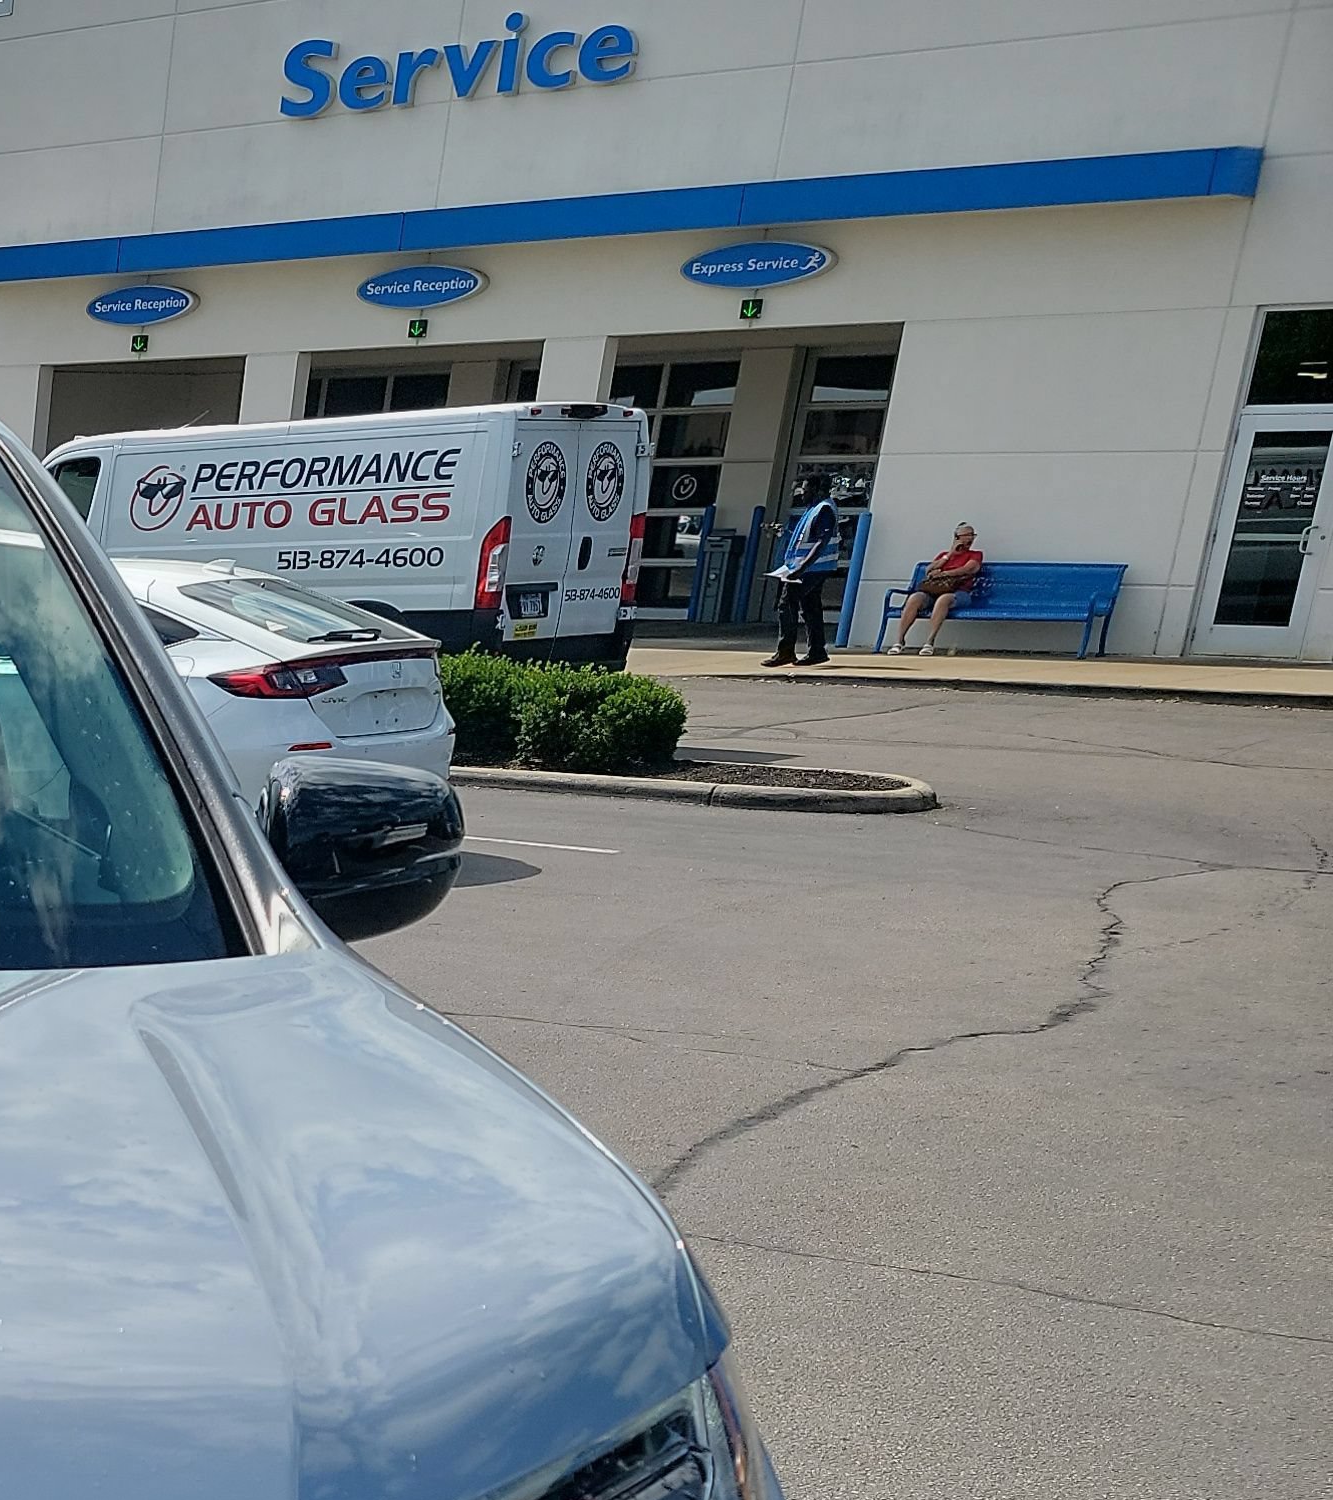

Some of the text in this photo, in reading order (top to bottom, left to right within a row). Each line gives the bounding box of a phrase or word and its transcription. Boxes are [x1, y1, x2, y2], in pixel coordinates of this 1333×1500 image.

[279, 12, 638, 119] Service
[691, 256, 799, 277] Express Service
[366, 277, 474, 295] Service Reception
[94, 296, 186, 313] Service Reception
[190, 447, 463, 493] PERFORMANCE
[528, 443, 566, 478] PERFORMANCE
[587, 443, 624, 478] PERFORMANCE
[184, 492, 452, 532] AUTO GLASS
[527, 494, 562, 521] AUTO GLASS
[587, 493, 620, 519] AUTO GLASS
[276, 546, 445, 570] 513-874-4600
[564, 586, 621, 602] 513-874-4600
